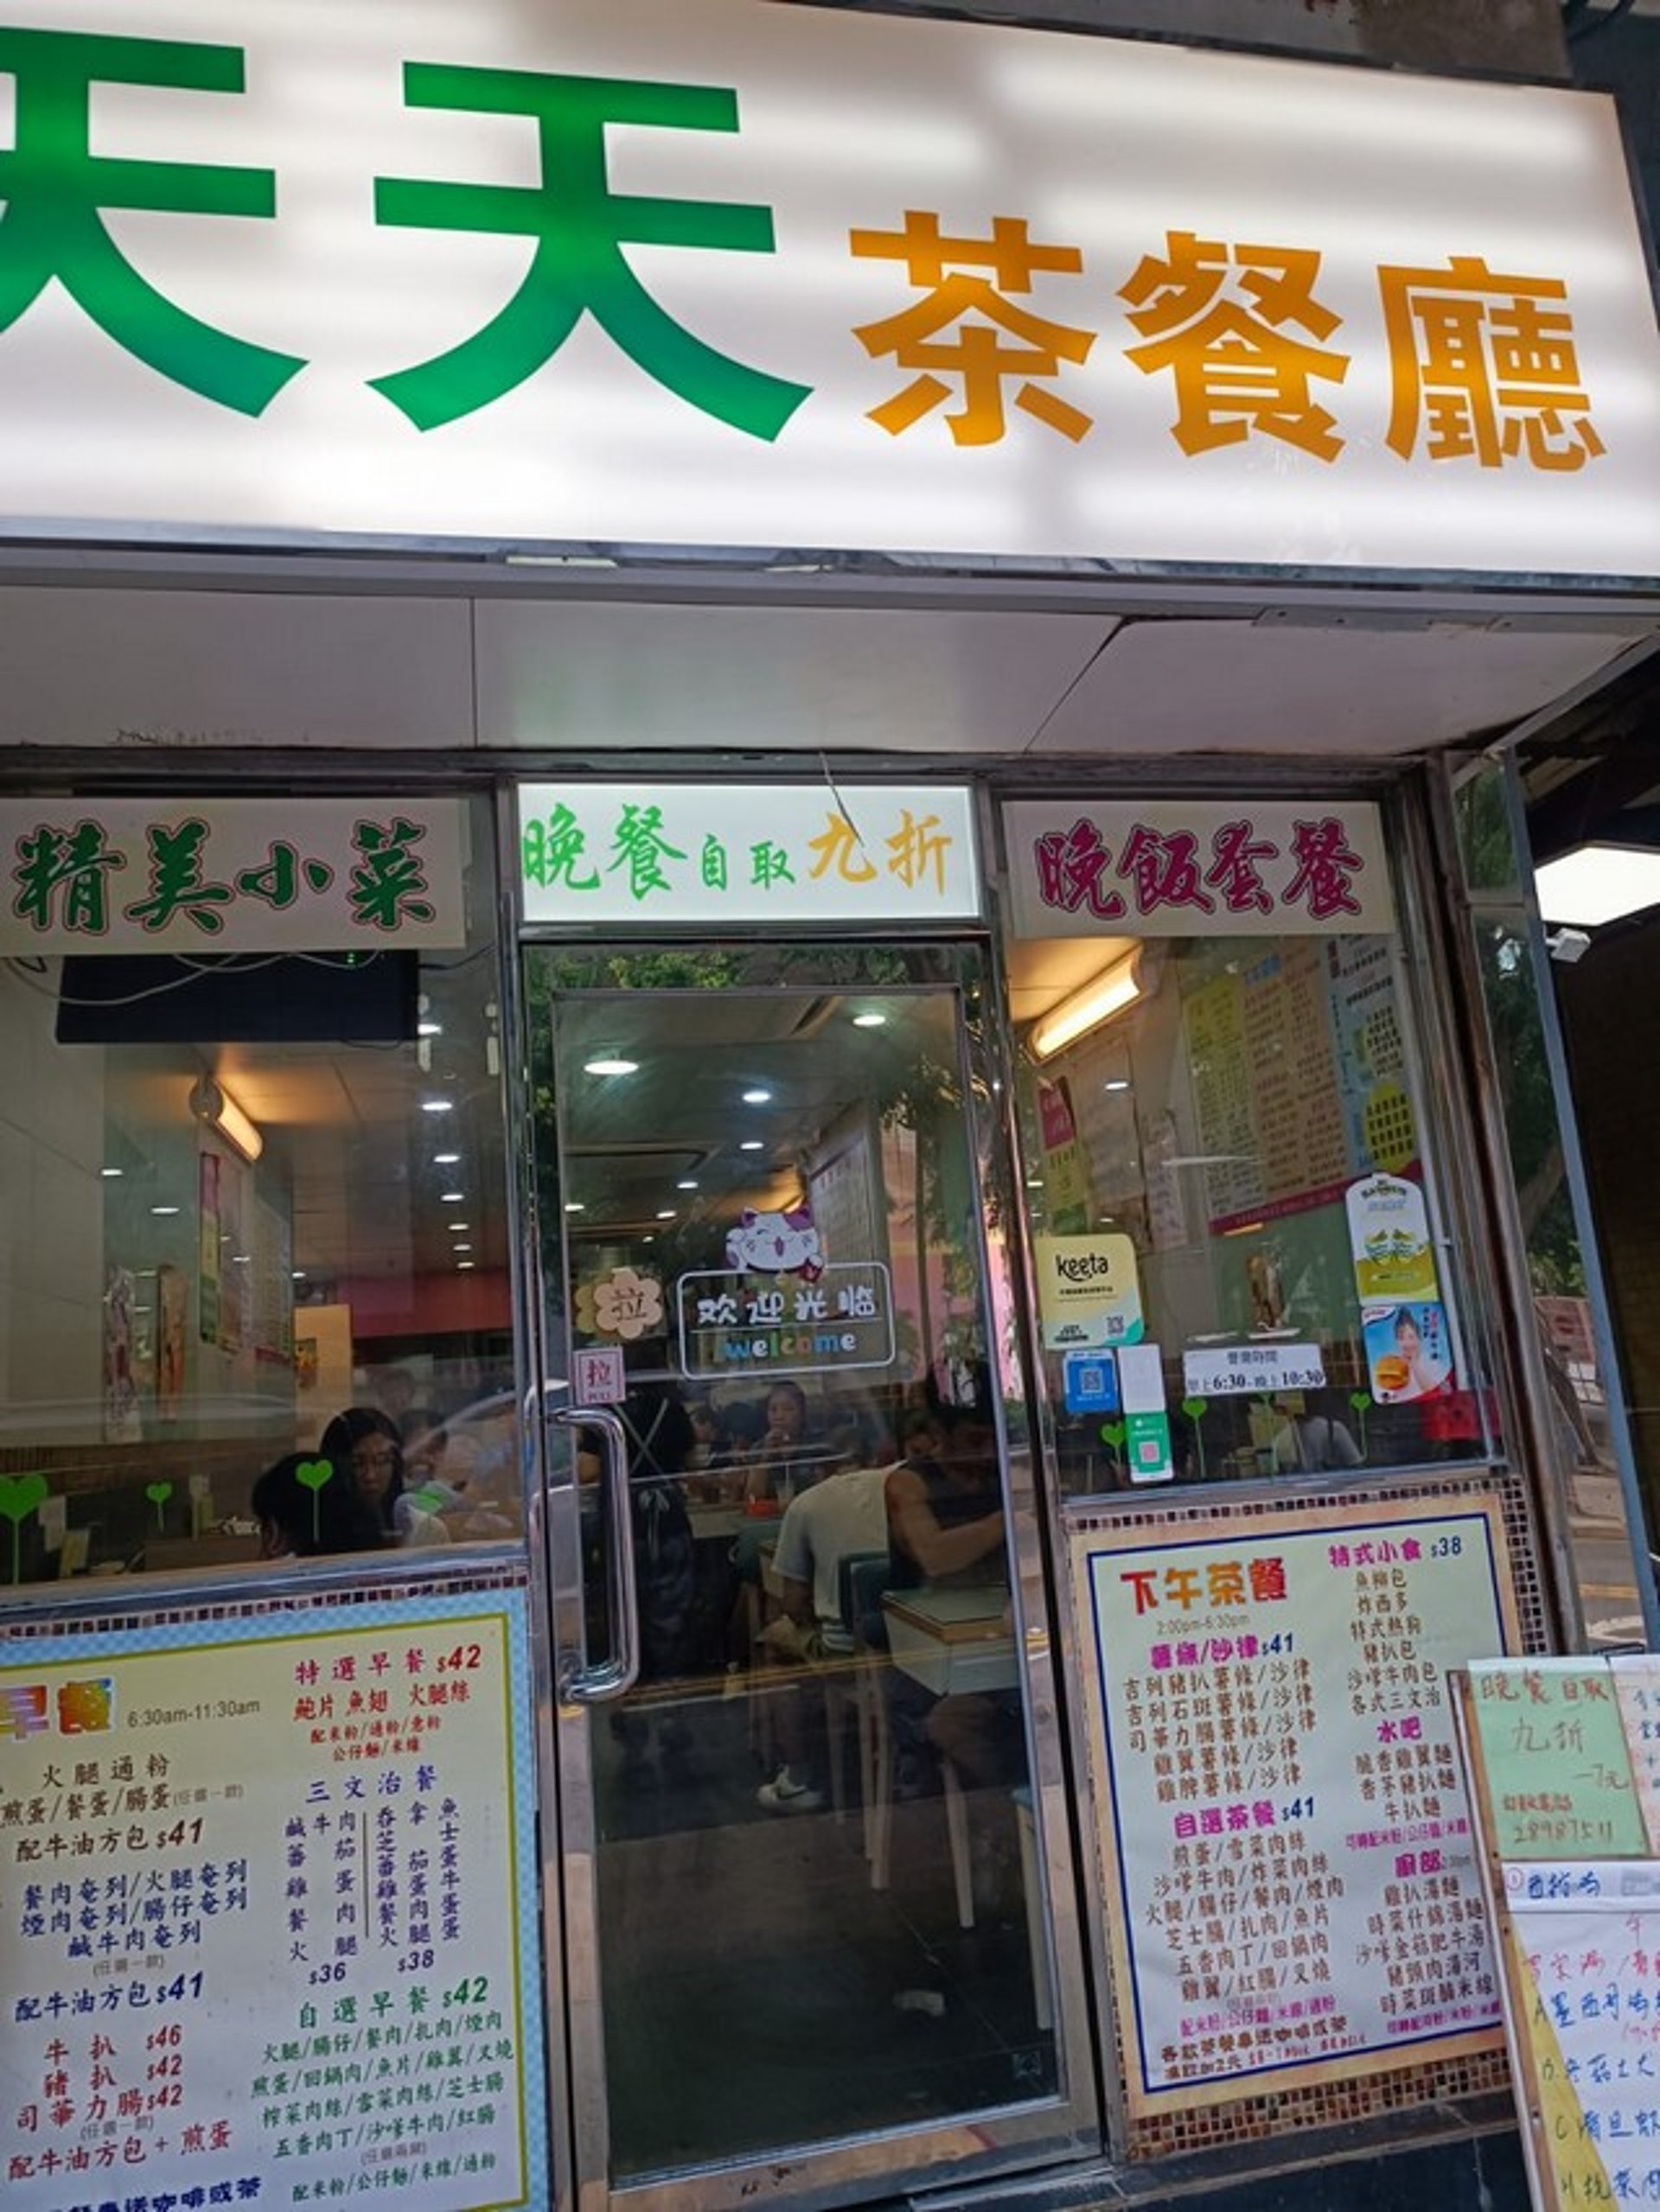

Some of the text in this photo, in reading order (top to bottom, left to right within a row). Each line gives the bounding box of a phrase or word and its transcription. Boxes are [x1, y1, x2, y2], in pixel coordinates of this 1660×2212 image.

[522, 802, 954, 901] 晚餐自取九折
[1035, 818, 1363, 920] 晚飯套餐
[13, 818, 435, 935] 精美小菜
[1055, 1253, 1109, 1283] keeta
[696, 1284, 877, 1325] 欢迎光临
[721, 1328, 858, 1363] welcome
[586, 1358, 613, 1388] 拉
[1120, 1557, 1286, 1616] 下午茶餐
[294, 1647, 427, 1686] 特選早餐
[126, 1699, 261, 1730] 6:30am-11:30am
[1352, 1687, 1440, 1716] 各式三文治
[42, 1752, 171, 1790] 火腿通粉
[305, 1764, 437, 1804] 三文治餐
[1173, 1800, 1276, 1839] 自選茶餐
[15, 1824, 150, 1864] 配牛油方包
[15, 1979, 152, 2024] 配牛油方包
[298, 1986, 430, 2030] 自選早餐
[44, 2033, 118, 2067] 牛扒
[16, 2087, 144, 2133] 司華力腸
[8, 2134, 147, 2182] 配牛油方包
[180, 2119, 233, 2157] 煎蛋
